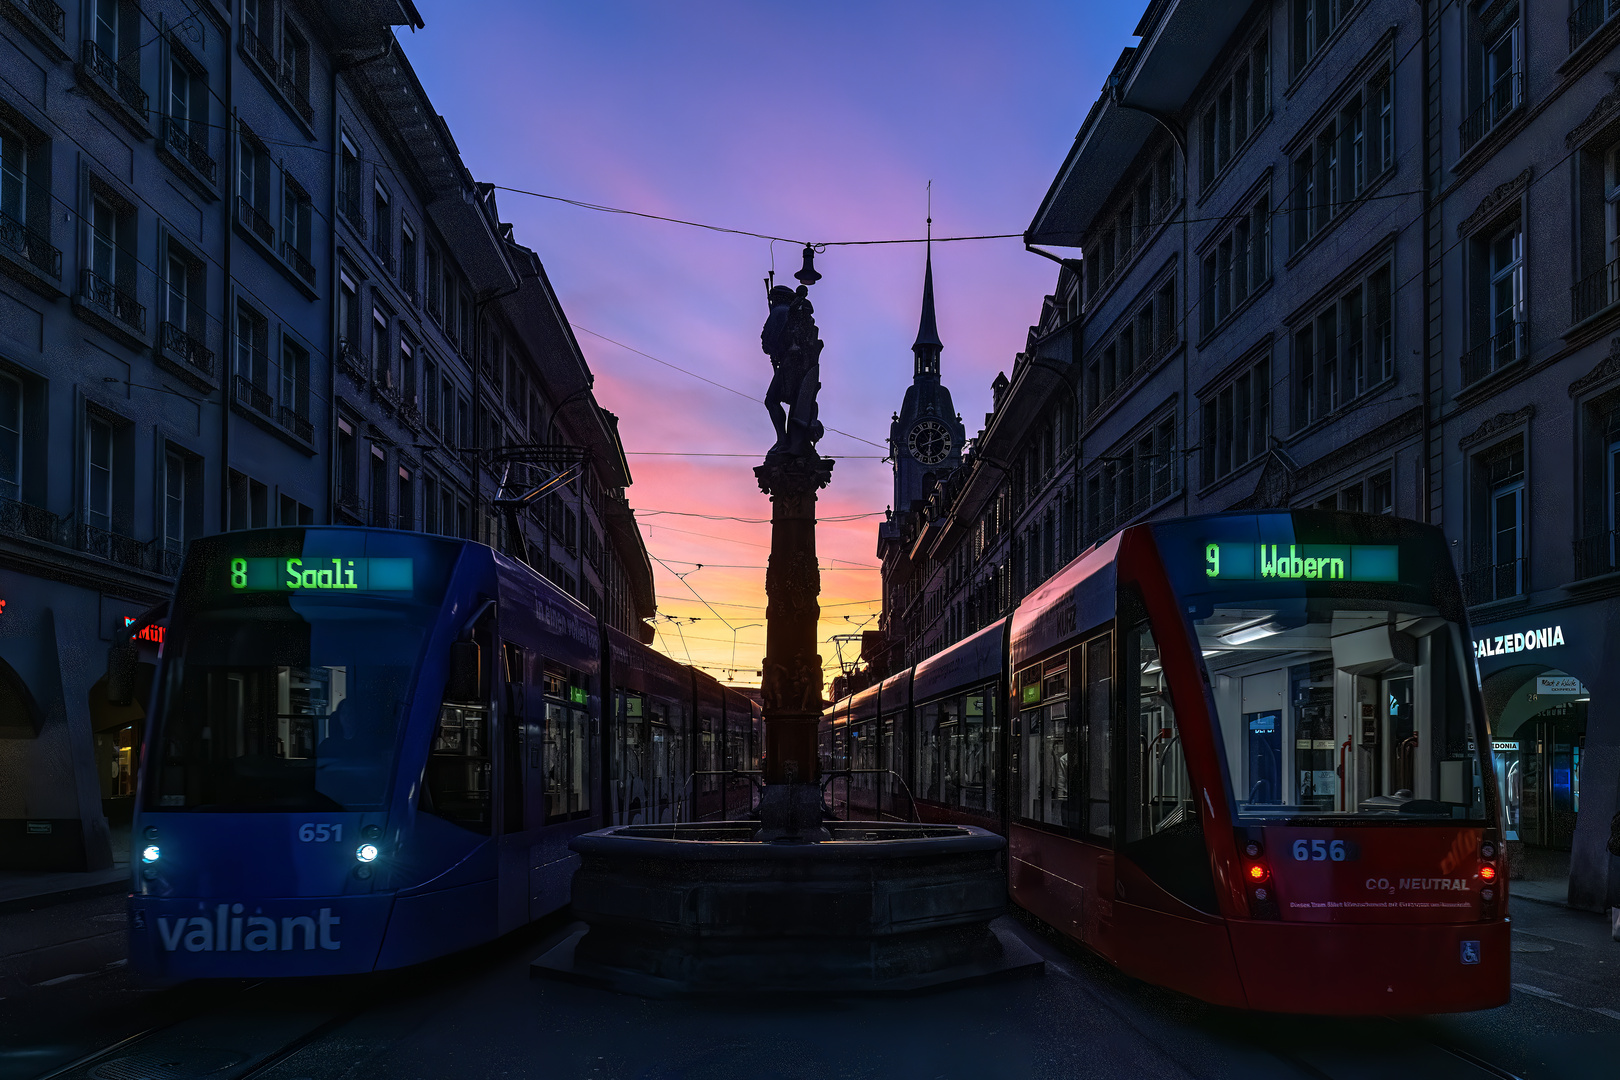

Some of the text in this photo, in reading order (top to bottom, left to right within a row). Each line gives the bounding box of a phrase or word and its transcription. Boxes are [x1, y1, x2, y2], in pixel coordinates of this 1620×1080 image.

[230, 558, 358, 588] 8 Saali
[1205, 543, 1344, 579] 9 Wabern
[299, 823, 343, 842] 651
[1292, 839, 1346, 862] 656
[1399, 878, 1471, 891] NEUTRAL
[157, 903, 341, 952] valiant
